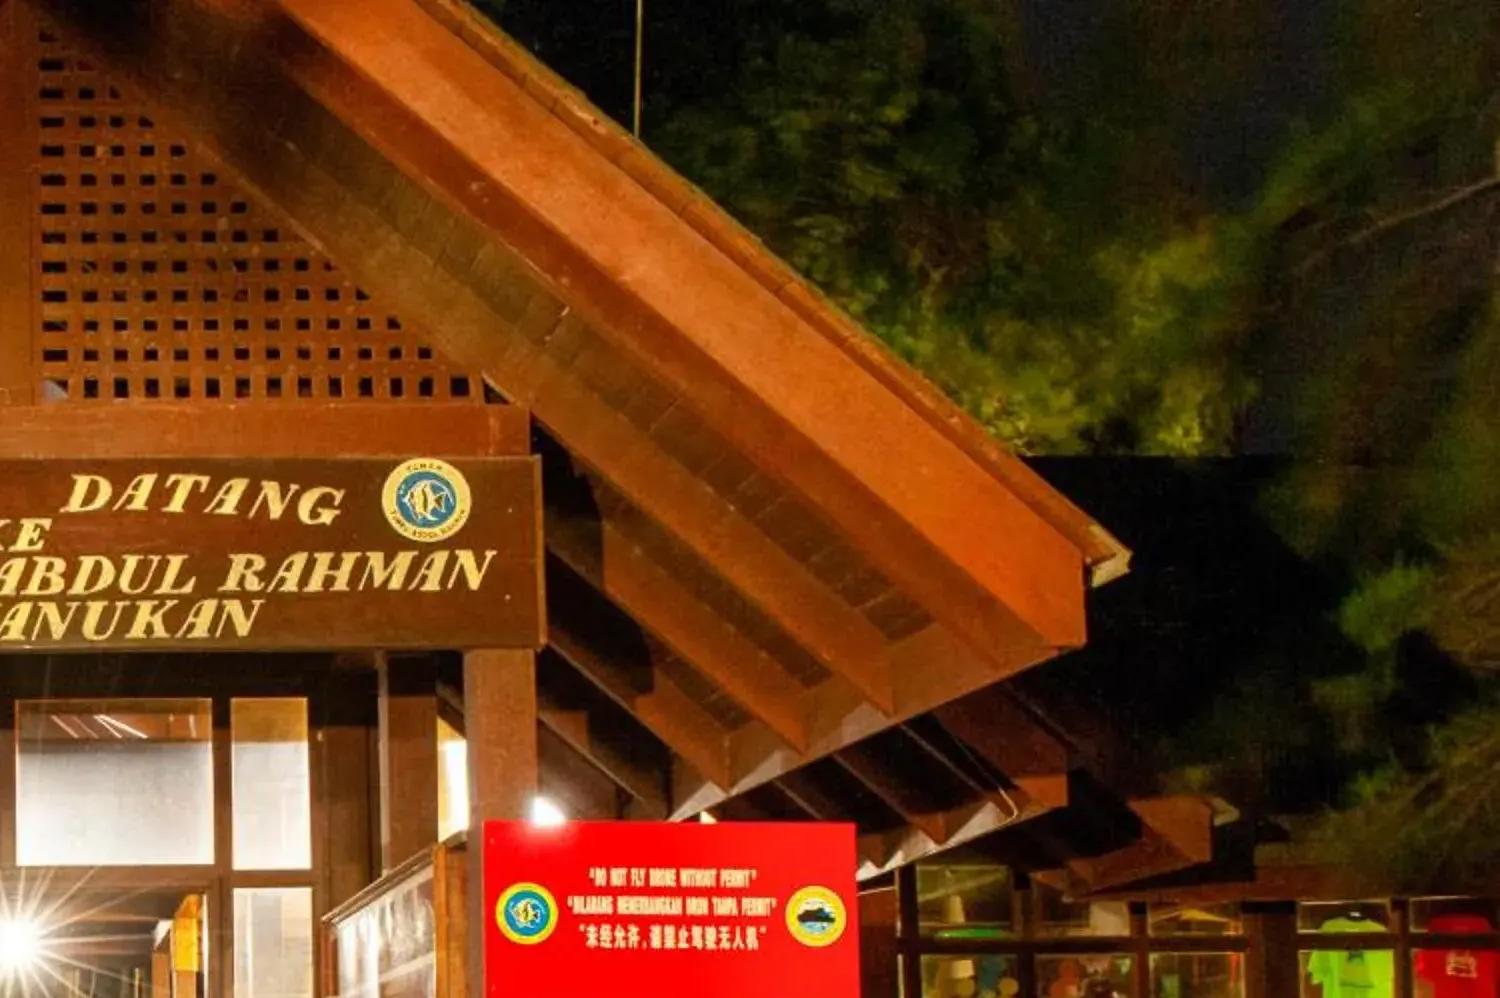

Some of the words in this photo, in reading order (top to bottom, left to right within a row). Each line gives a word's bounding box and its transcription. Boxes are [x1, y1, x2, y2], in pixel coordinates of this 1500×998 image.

[59, 473, 345, 526] DATANG
[217, 548, 498, 594] RAHMAN
[631, 867, 646, 887] FLY
[680, 868, 717, 888] WITHOUT
